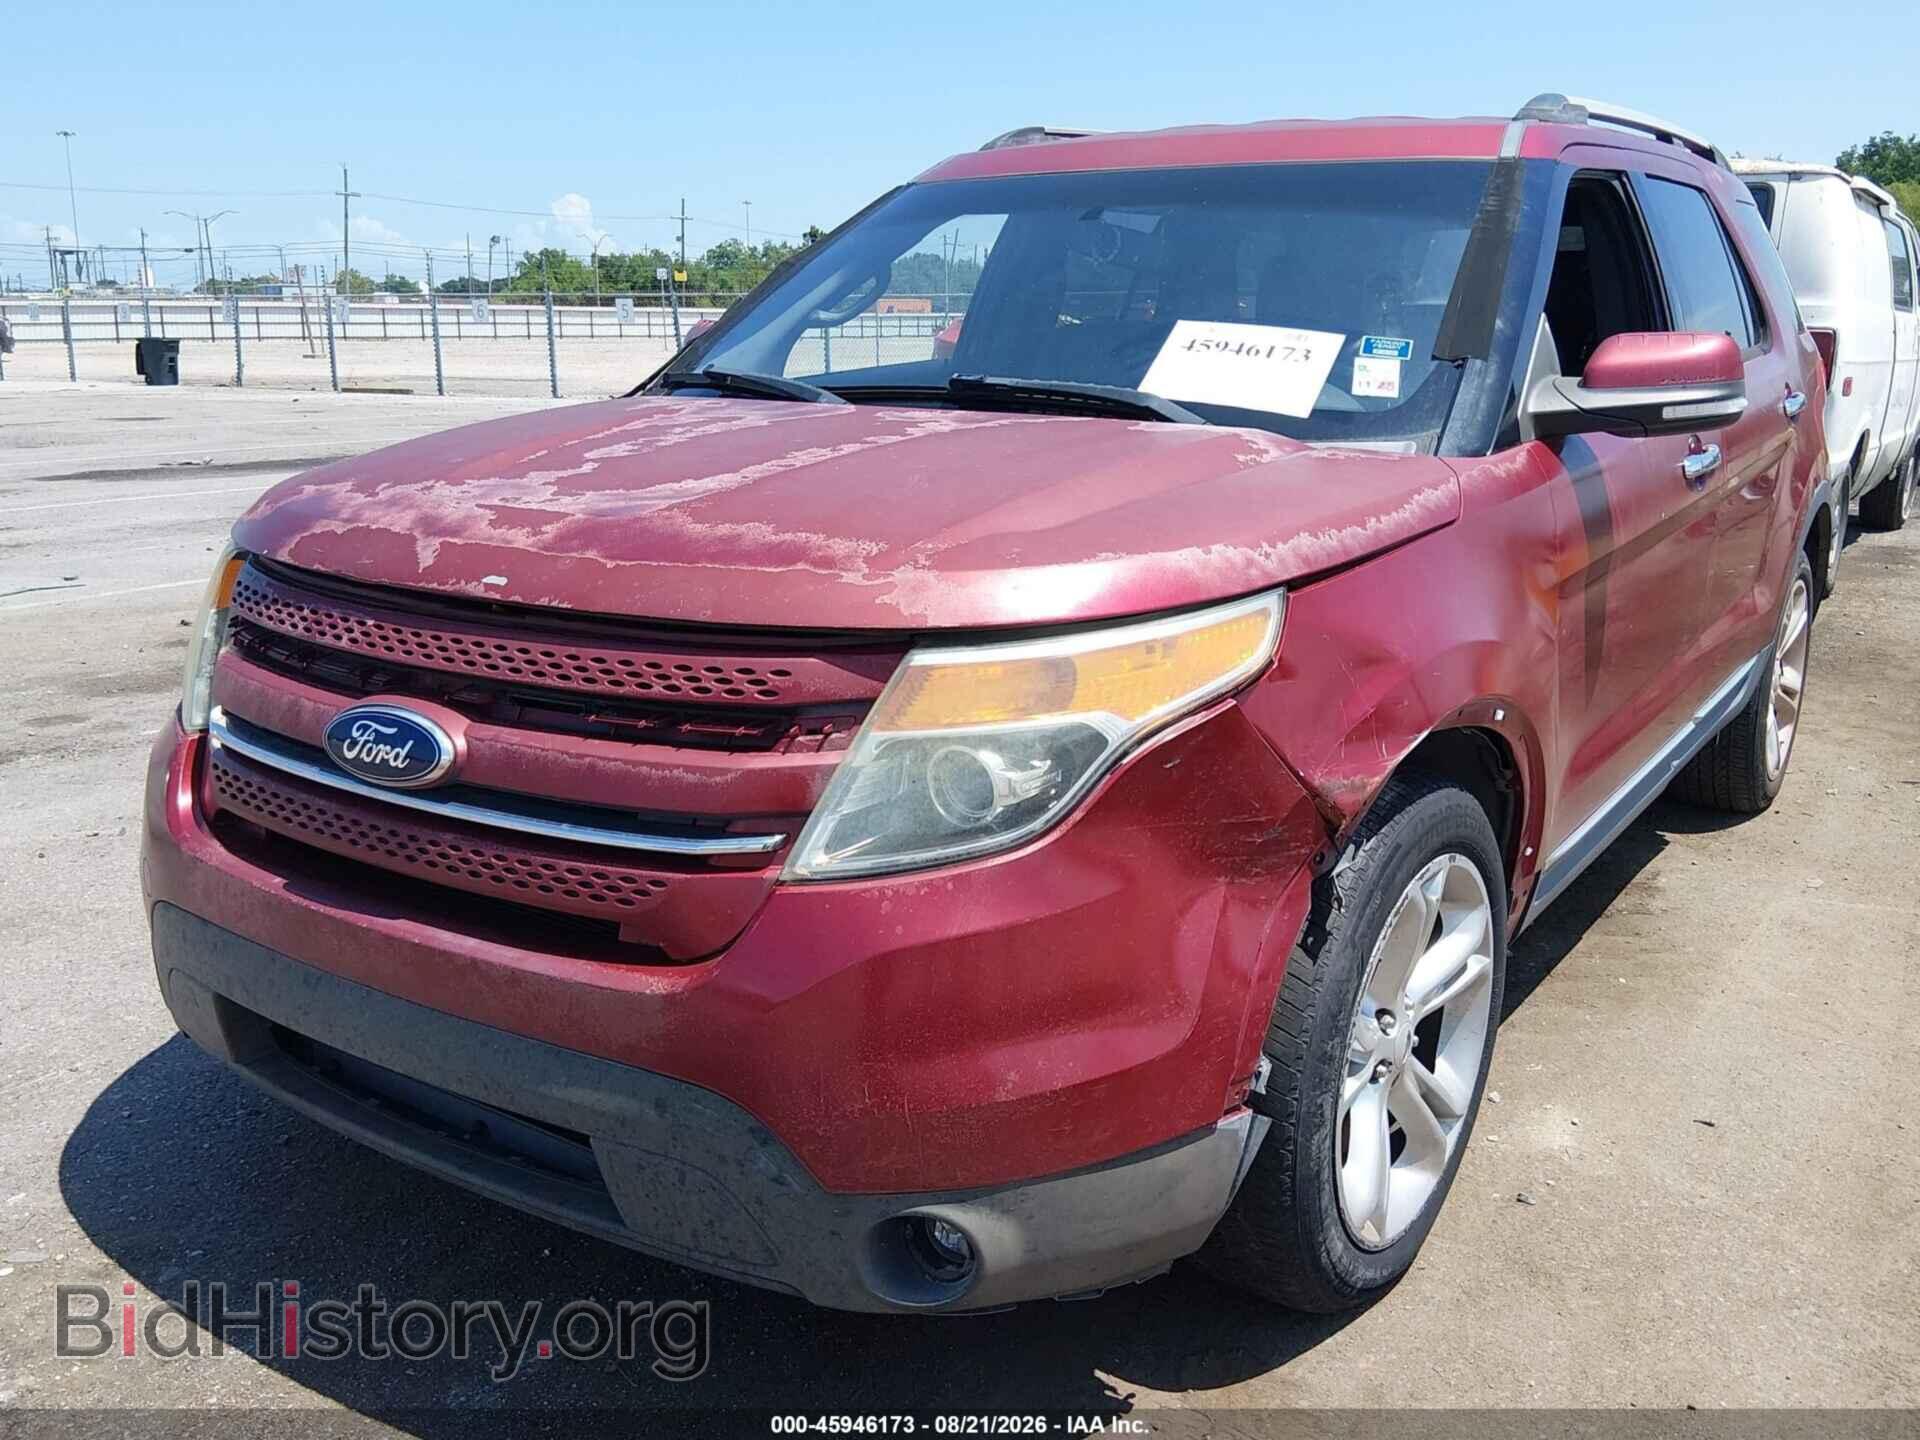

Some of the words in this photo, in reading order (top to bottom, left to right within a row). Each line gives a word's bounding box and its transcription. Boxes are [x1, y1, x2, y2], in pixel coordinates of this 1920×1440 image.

[476, 303, 486, 319] 6
[621, 303, 629, 319] 5
[1180, 337, 1312, 363] 45946173
[343, 720, 414, 768] Ford
